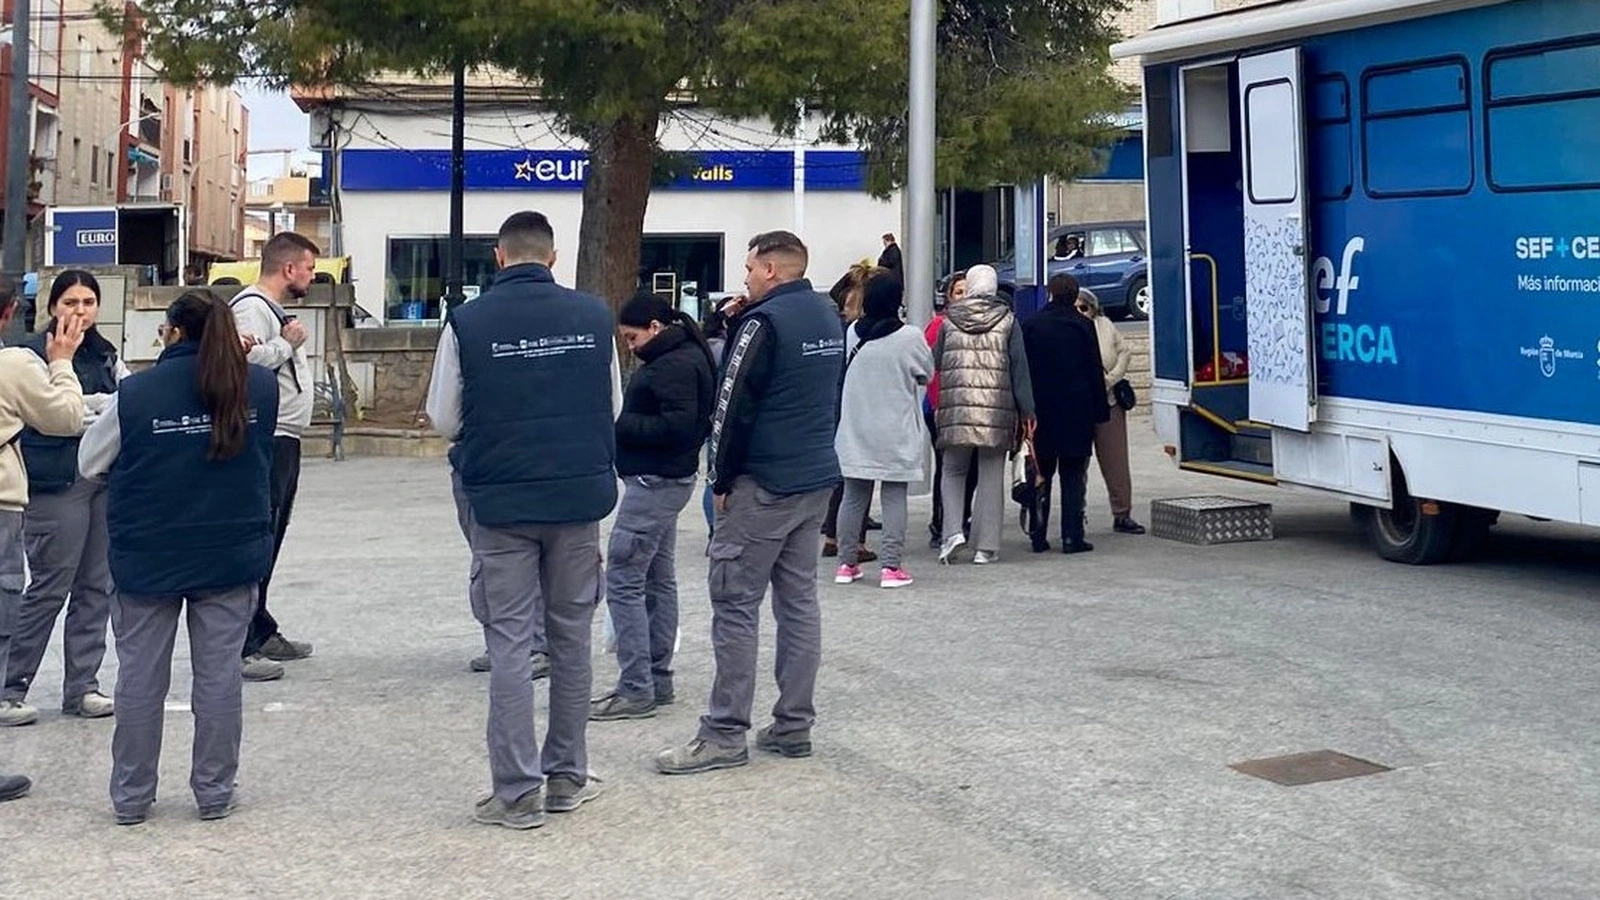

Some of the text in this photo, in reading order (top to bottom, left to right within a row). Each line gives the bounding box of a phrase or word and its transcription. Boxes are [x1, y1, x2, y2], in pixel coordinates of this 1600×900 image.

[81, 232, 115, 244] EURO
[1518, 274, 1542, 292] Más
[1322, 322, 1398, 365] ERCA
